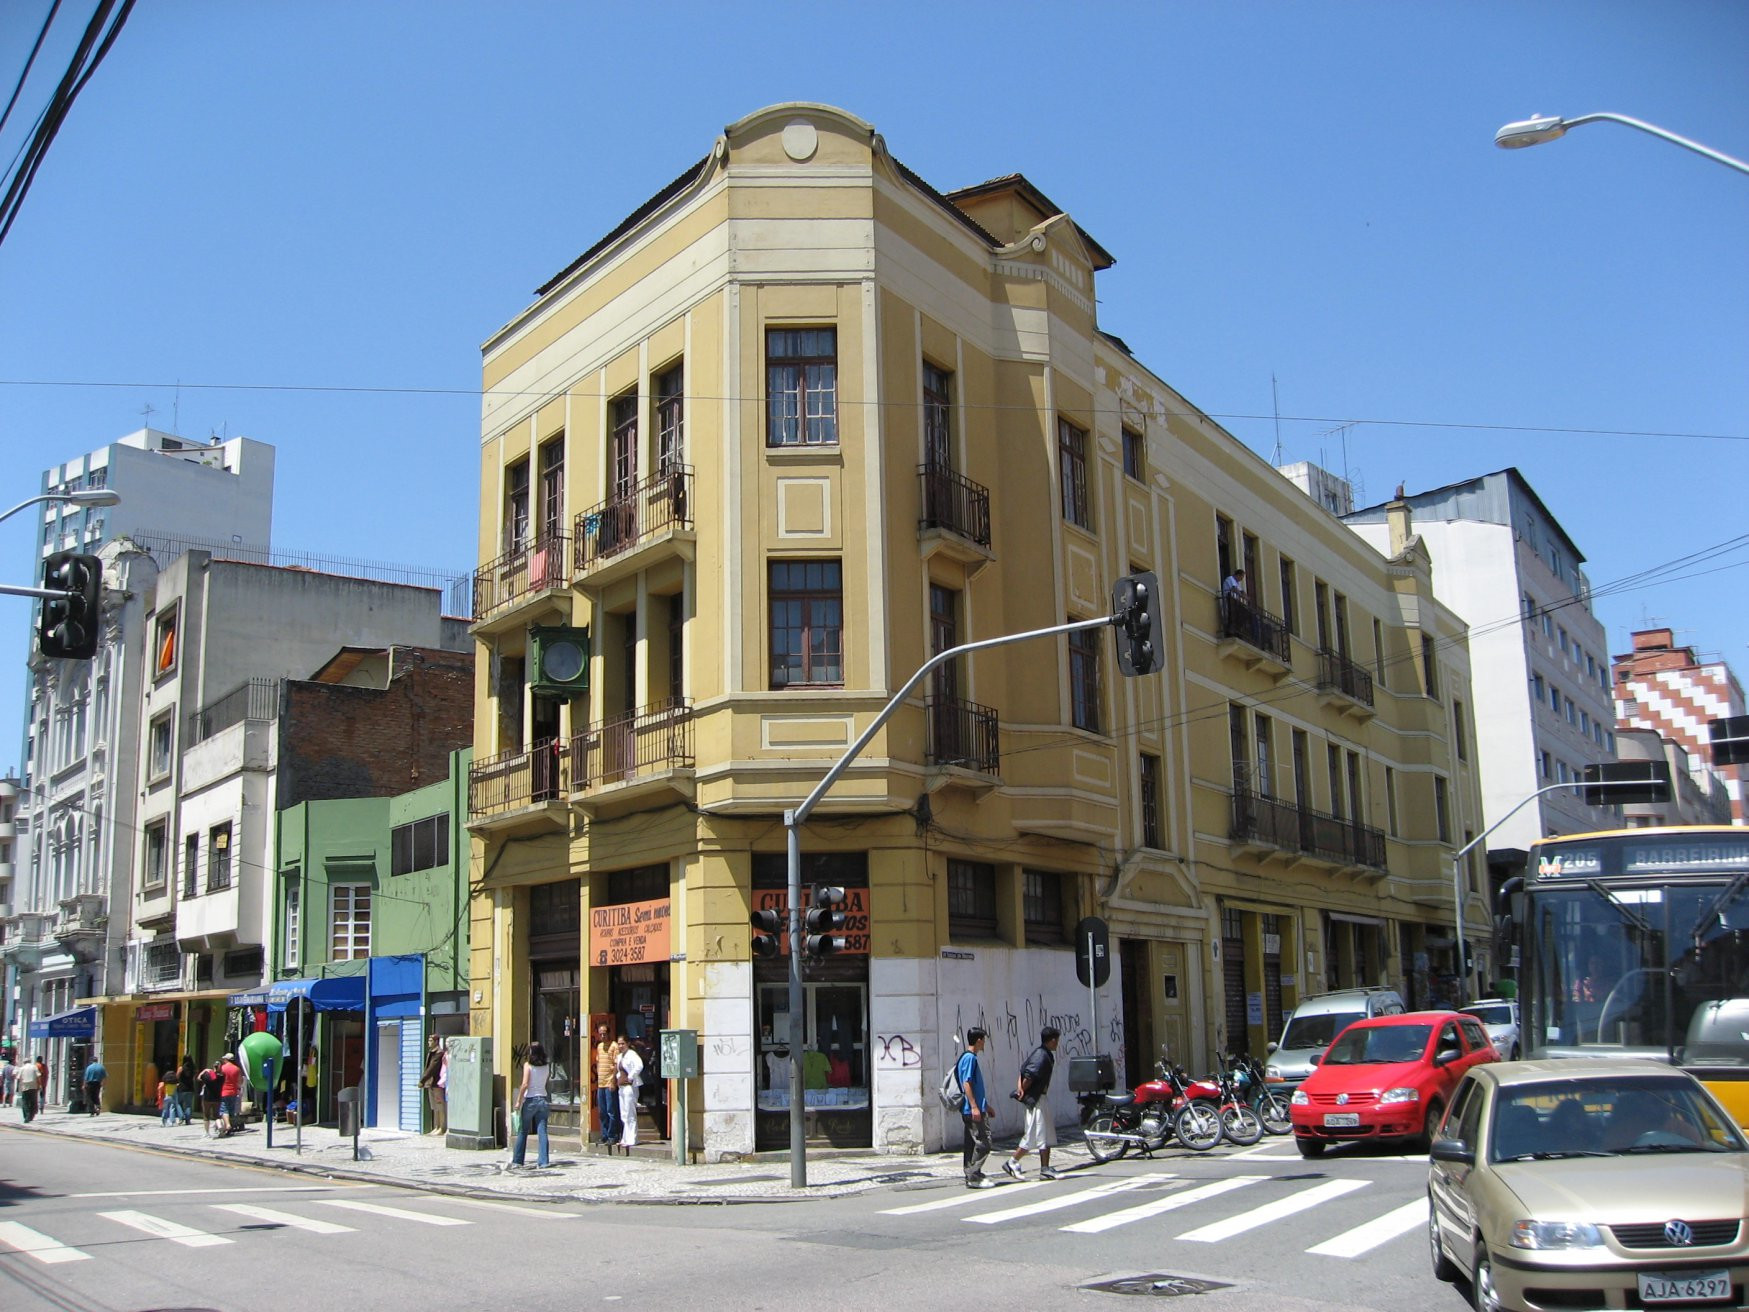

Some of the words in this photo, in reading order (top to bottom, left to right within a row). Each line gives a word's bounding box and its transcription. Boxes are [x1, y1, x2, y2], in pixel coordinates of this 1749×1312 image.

[1564, 852, 1597, 868] 205
[760, 891, 864, 913] CUIBA
[593, 906, 631, 928] CURITIBA
[634, 905, 652, 923] Semi
[609, 937, 627, 947] COMPRA
[633, 935, 647, 945] VENDA
[611, 946, 646, 963] 3024-3587
